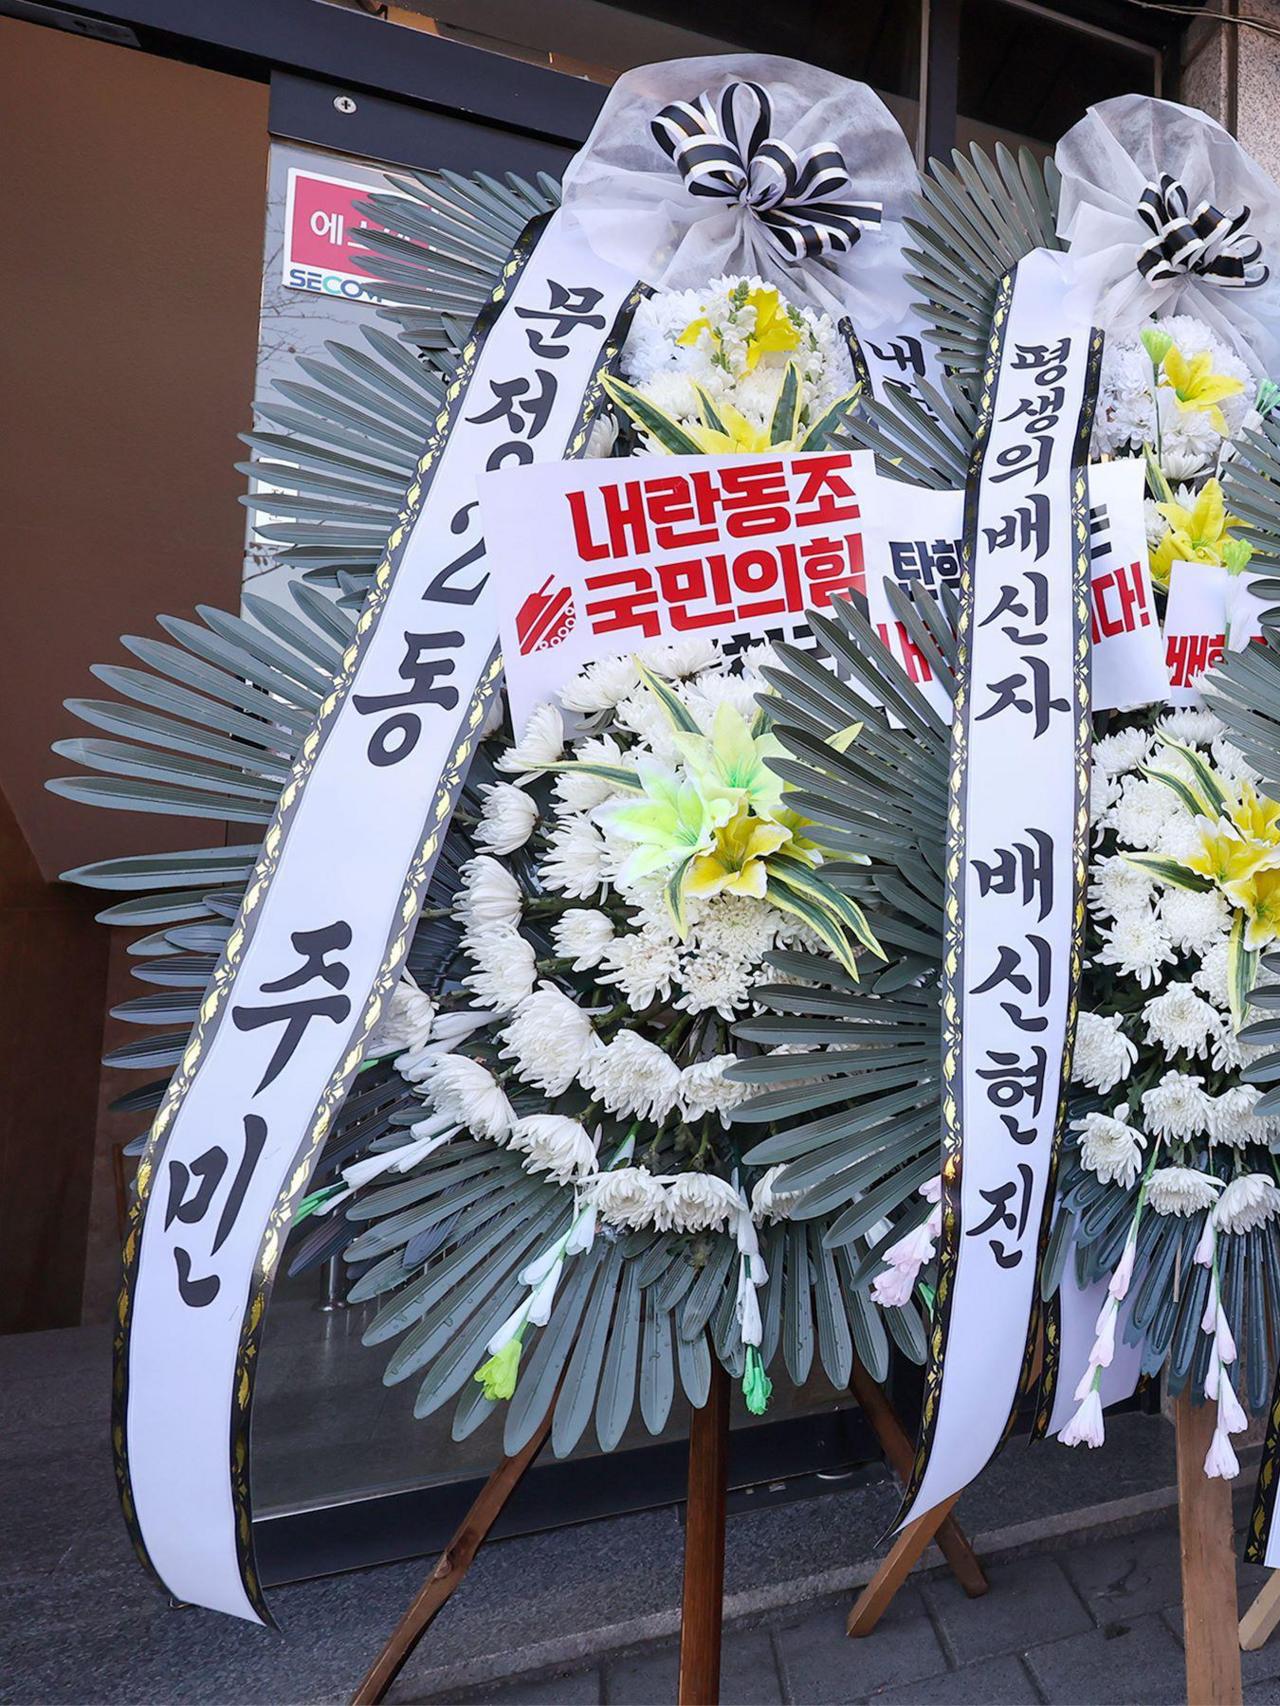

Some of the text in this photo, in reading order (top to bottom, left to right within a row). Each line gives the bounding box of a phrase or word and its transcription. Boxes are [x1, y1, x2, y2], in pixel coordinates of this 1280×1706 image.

[289, 268, 383, 303] SECO
[565, 454, 862, 563] 내란동조
[584, 533, 868, 639] 국민의힘
[965, 827, 1054, 1269] 배신현진
[164, 920, 354, 1308] 주민
